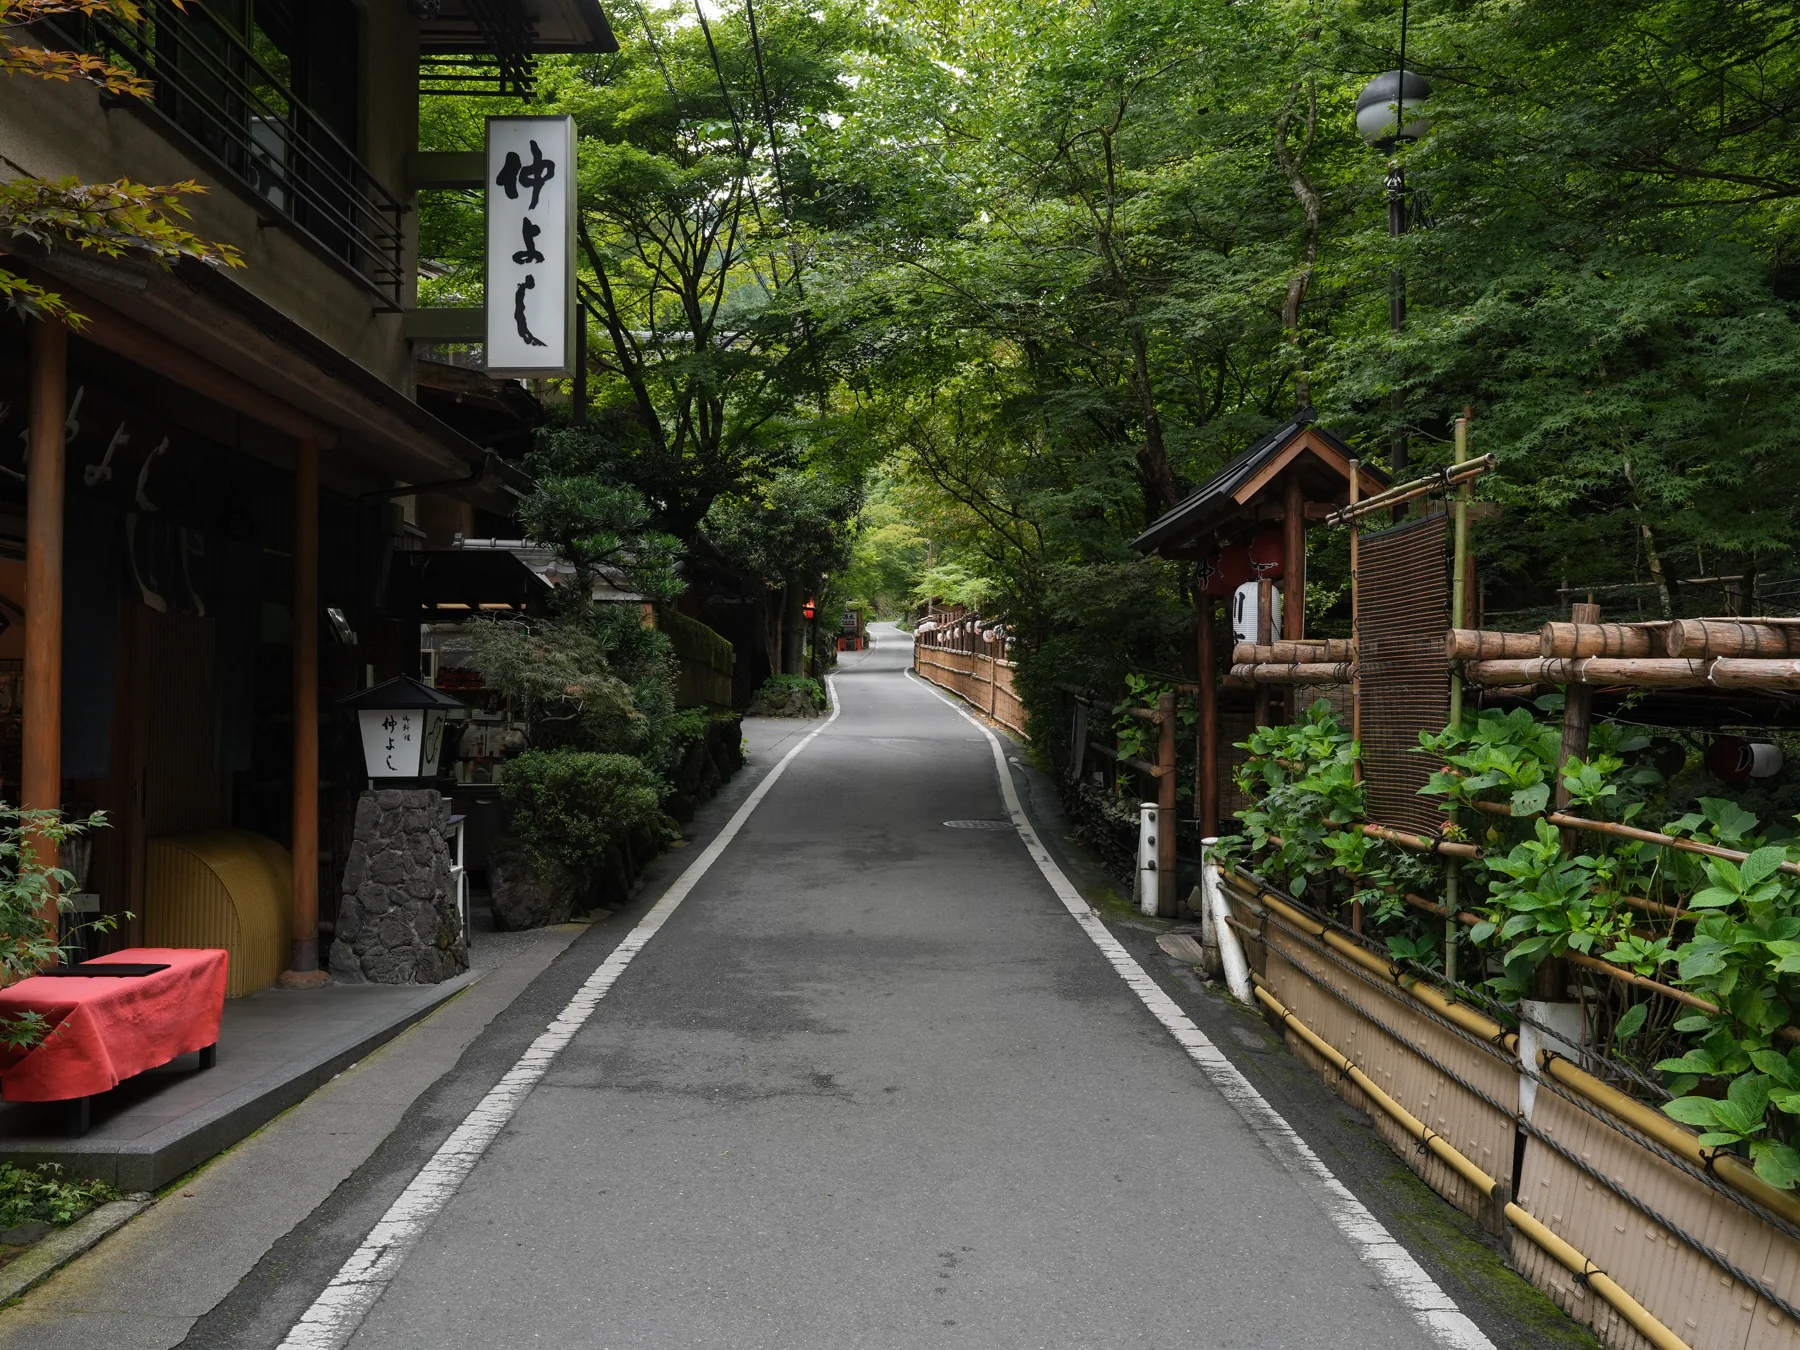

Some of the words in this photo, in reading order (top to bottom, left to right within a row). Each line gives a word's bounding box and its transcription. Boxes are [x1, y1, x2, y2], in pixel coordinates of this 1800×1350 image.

[496, 139, 556, 347] 仲よし
[382, 715, 398, 771] 仲よし
